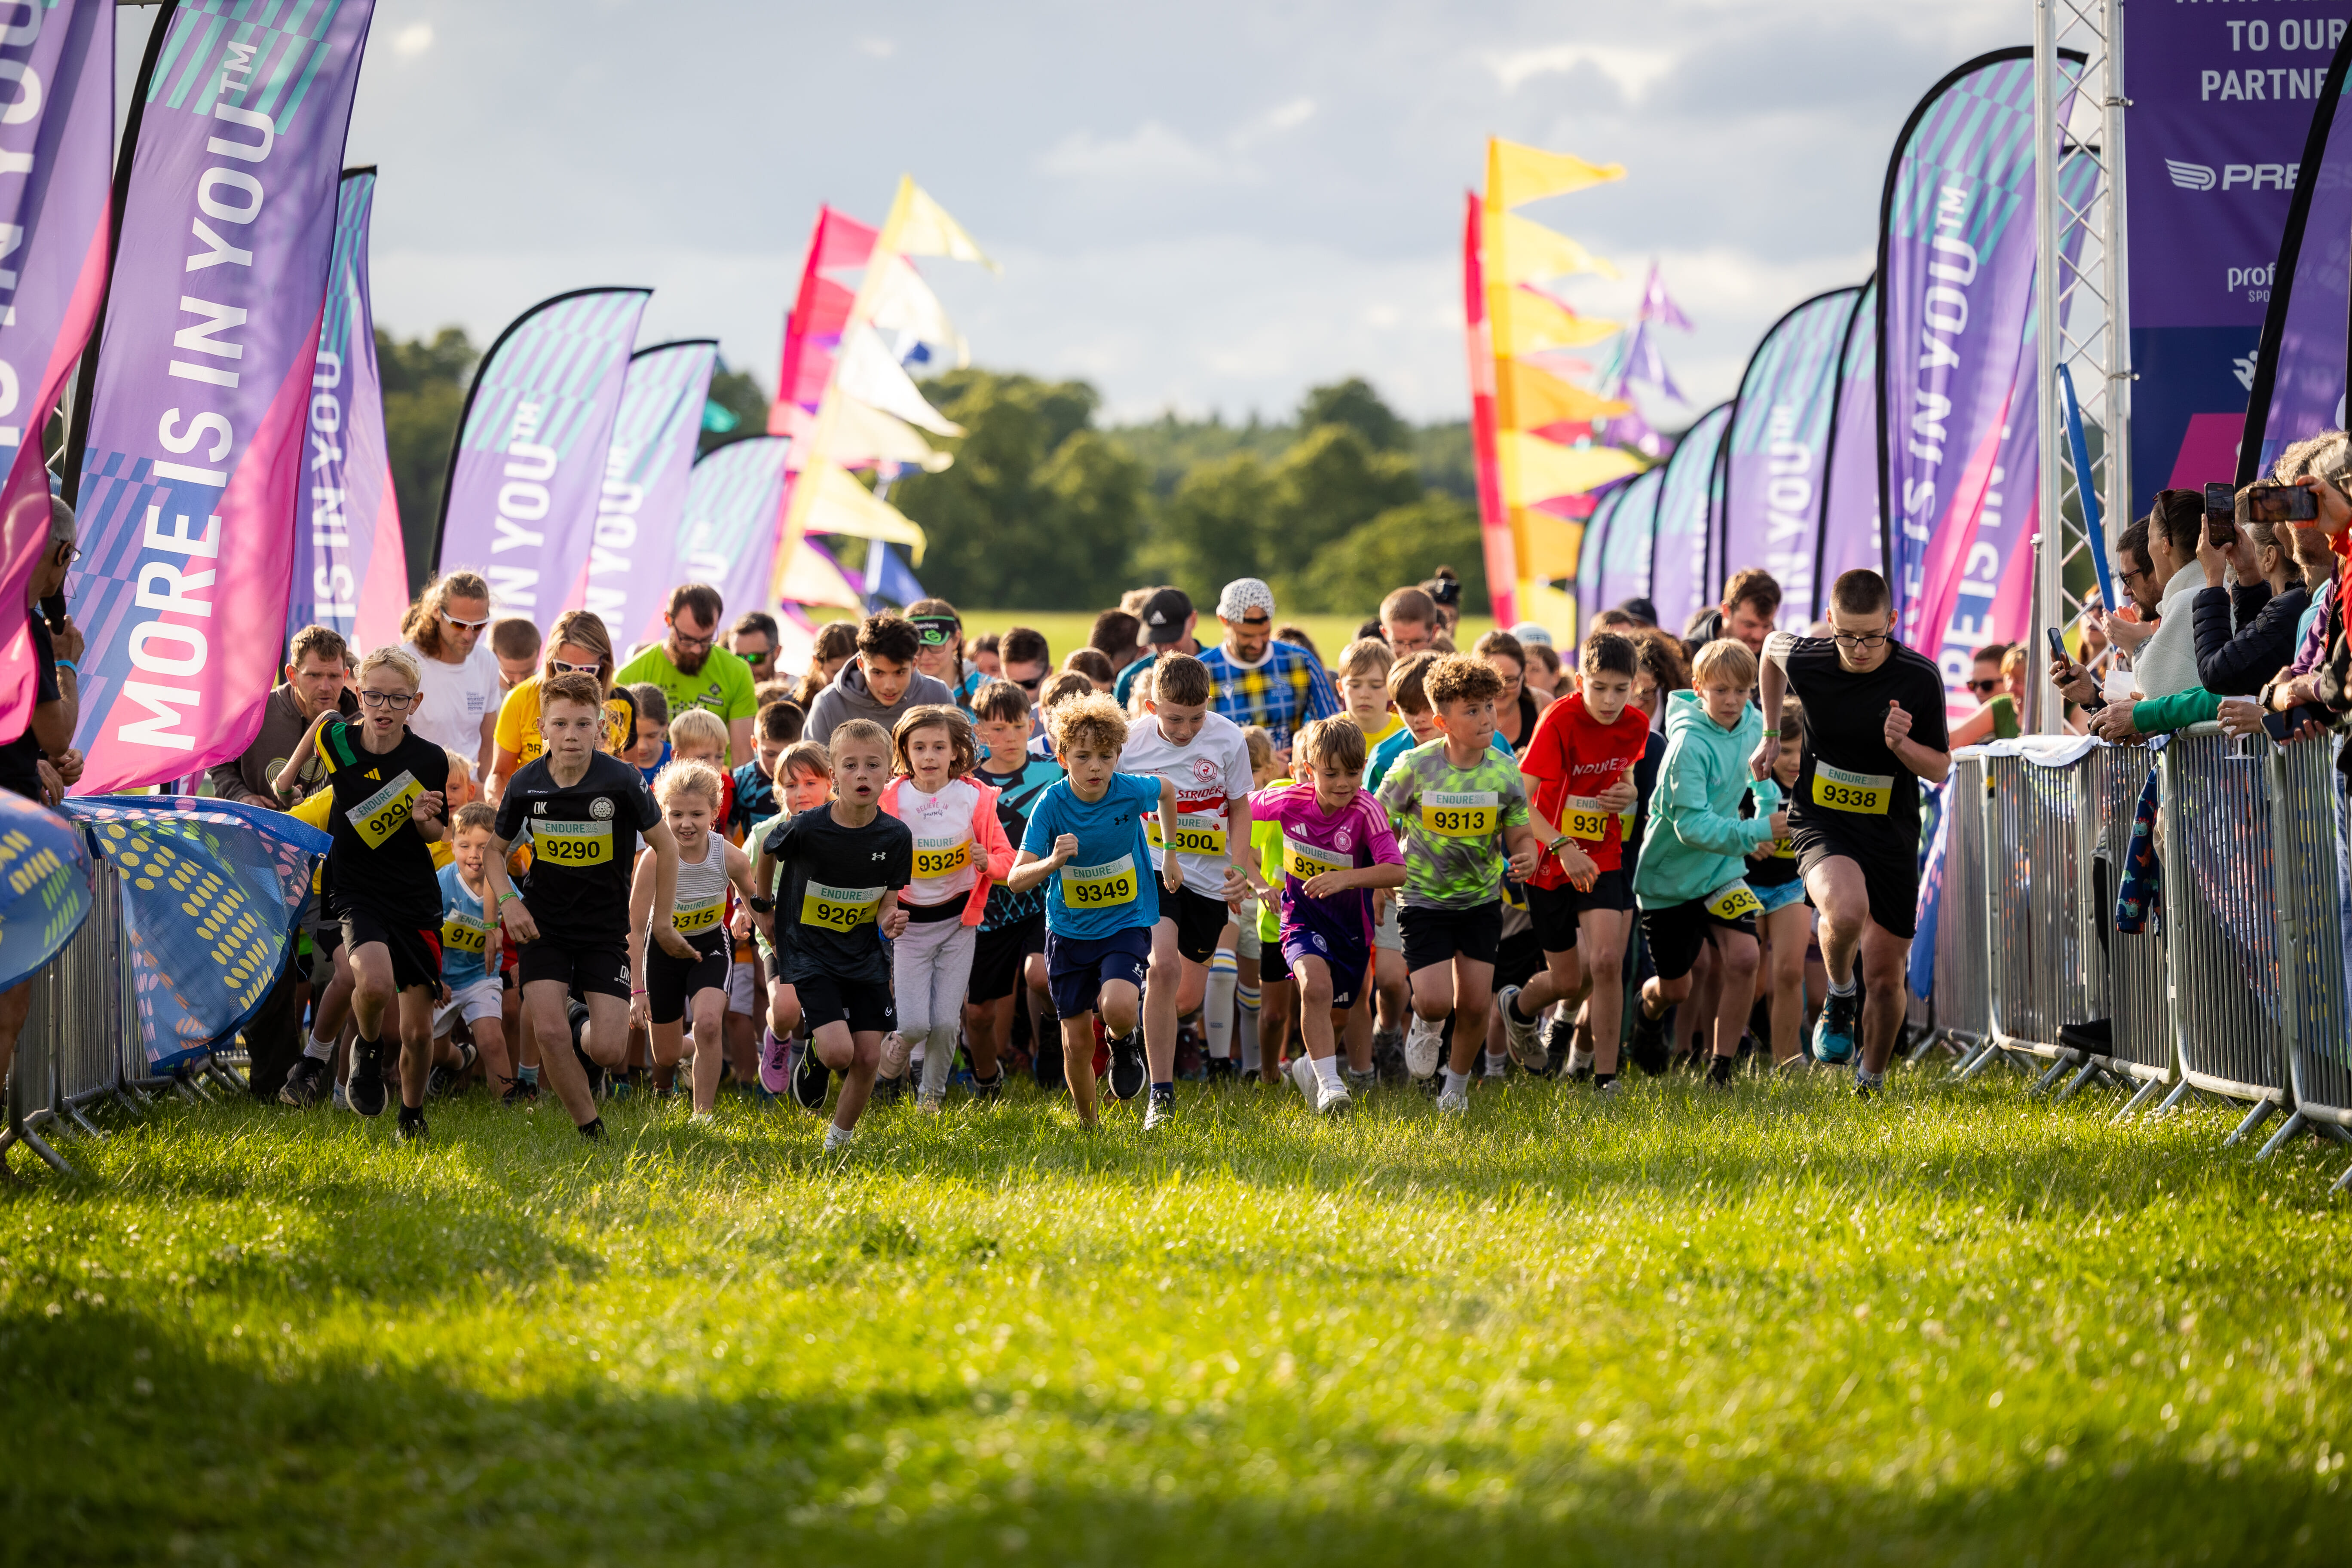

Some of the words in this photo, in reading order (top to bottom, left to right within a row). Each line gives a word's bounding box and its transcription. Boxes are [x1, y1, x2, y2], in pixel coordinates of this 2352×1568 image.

[2226, 19, 2269, 51] TO
[2279, 18, 2348, 51] OUR
[168, 295, 248, 388] IN
[310, 322, 343, 472] YOU
[1908, 387, 1952, 466] IN
[153, 407, 233, 488] IS
[312, 486, 349, 548] IN
[314, 564, 358, 618] IS
[117, 505, 222, 751] MORE
[1828, 769, 1879, 785] ENDURE24
[358, 781, 402, 816] ENDURE24
[916, 802, 939, 814] BELIEVE
[1436, 795, 1485, 805] ENDURE24
[1823, 785, 1877, 808] 9338
[370, 793, 414, 836] 9294
[923, 809, 943, 820] yourself
[1435, 812, 1485, 830] 9313
[545, 823, 598, 833] ENDURE24
[546, 840, 600, 860] 9290
[918, 833, 963, 847] ENDURE24
[918, 847, 965, 872] 9325
[1294, 842, 1340, 863] ENDURE24
[1073, 861, 1124, 878] ENDURE24
[1295, 857, 1338, 877] 931
[821, 887, 874, 900] ENDURE24
[1076, 879, 1129, 902] 9349
[1722, 891, 1757, 915] 933
[672, 910, 715, 928] 9315
